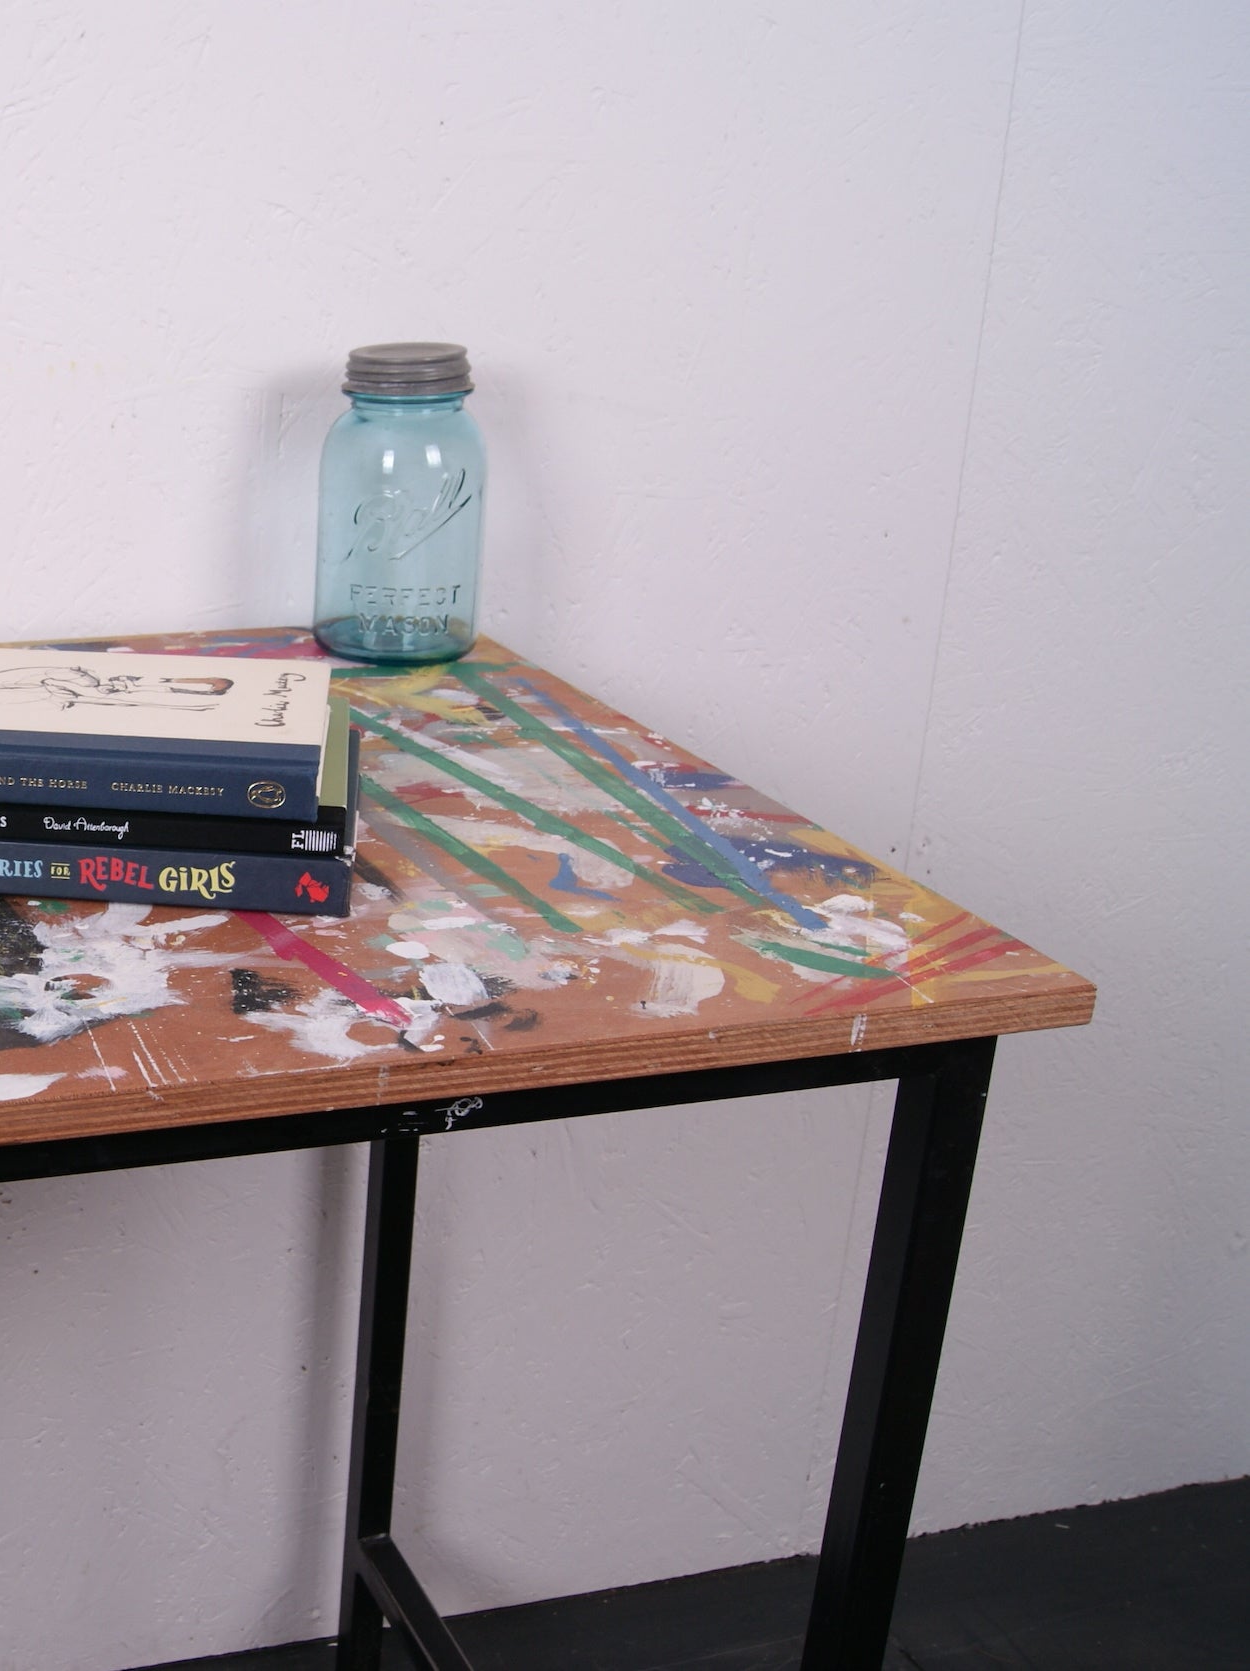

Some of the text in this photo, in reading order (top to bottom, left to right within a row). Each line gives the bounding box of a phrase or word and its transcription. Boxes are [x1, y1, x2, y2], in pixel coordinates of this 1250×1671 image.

[342, 468, 471, 562] Ball
[350, 583, 461, 606] PERFECT
[358, 612, 449, 636] MASON
[20, 777, 44, 788] THE
[49, 779, 88, 790] HORSE
[111, 782, 224, 797] CHARLIE MACKESY
[43, 816, 72, 831] David
[51, 865, 71, 877] FOR
[78, 856, 155, 892] REBEL
